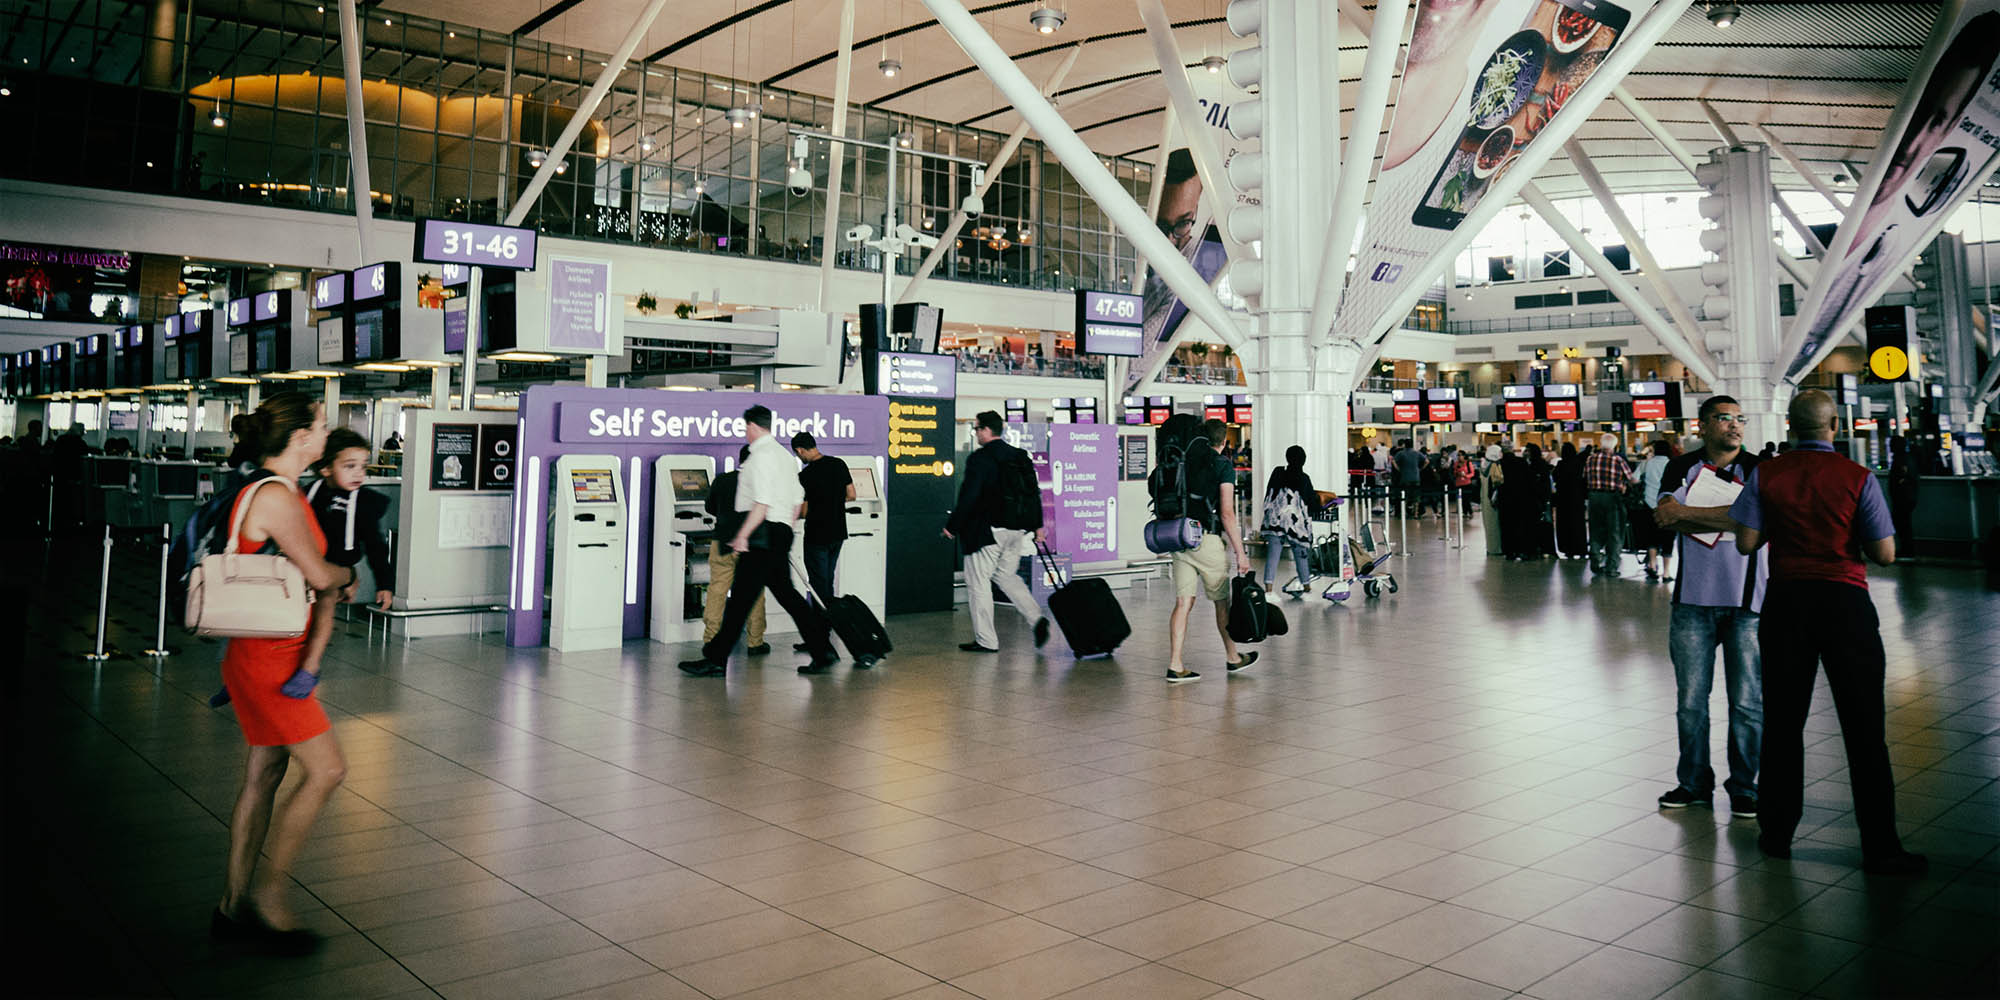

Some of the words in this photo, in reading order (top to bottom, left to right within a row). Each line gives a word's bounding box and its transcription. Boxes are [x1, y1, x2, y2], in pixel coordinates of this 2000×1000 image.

[443, 229, 518, 259] 31-46
[371, 265, 385, 291] 45
[317, 280, 329, 303] 44
[1095, 298, 1135, 318] 47-60
[1503, 386, 1517, 397] 72
[1562, 385, 1577, 395] 73
[588, 407, 644, 437] Self
[650, 409, 747, 438] Service
[771, 410, 827, 438] heck
[834, 413, 855, 438] In
[1070, 431, 1100, 441] Domestic
[1072, 444, 1097, 453] Airlines
